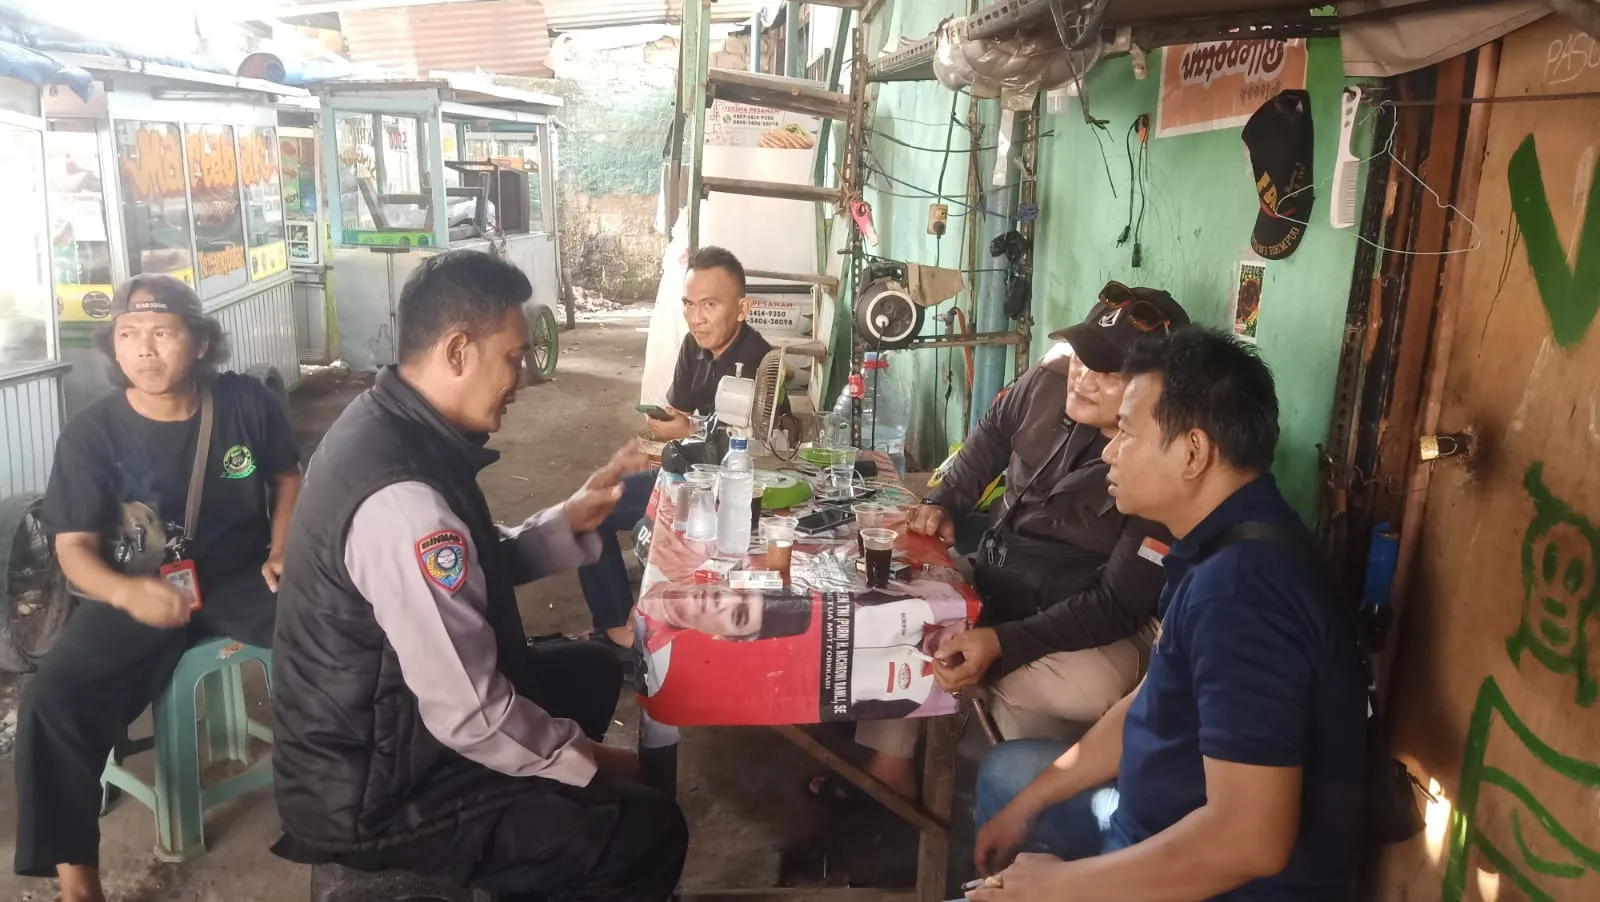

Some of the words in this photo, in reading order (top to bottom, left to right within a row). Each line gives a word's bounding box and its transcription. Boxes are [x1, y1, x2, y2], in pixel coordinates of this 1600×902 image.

[837, 604, 850, 617] TNI
[832, 618, 850, 641] (PURN)
[833, 704, 847, 714] SE
